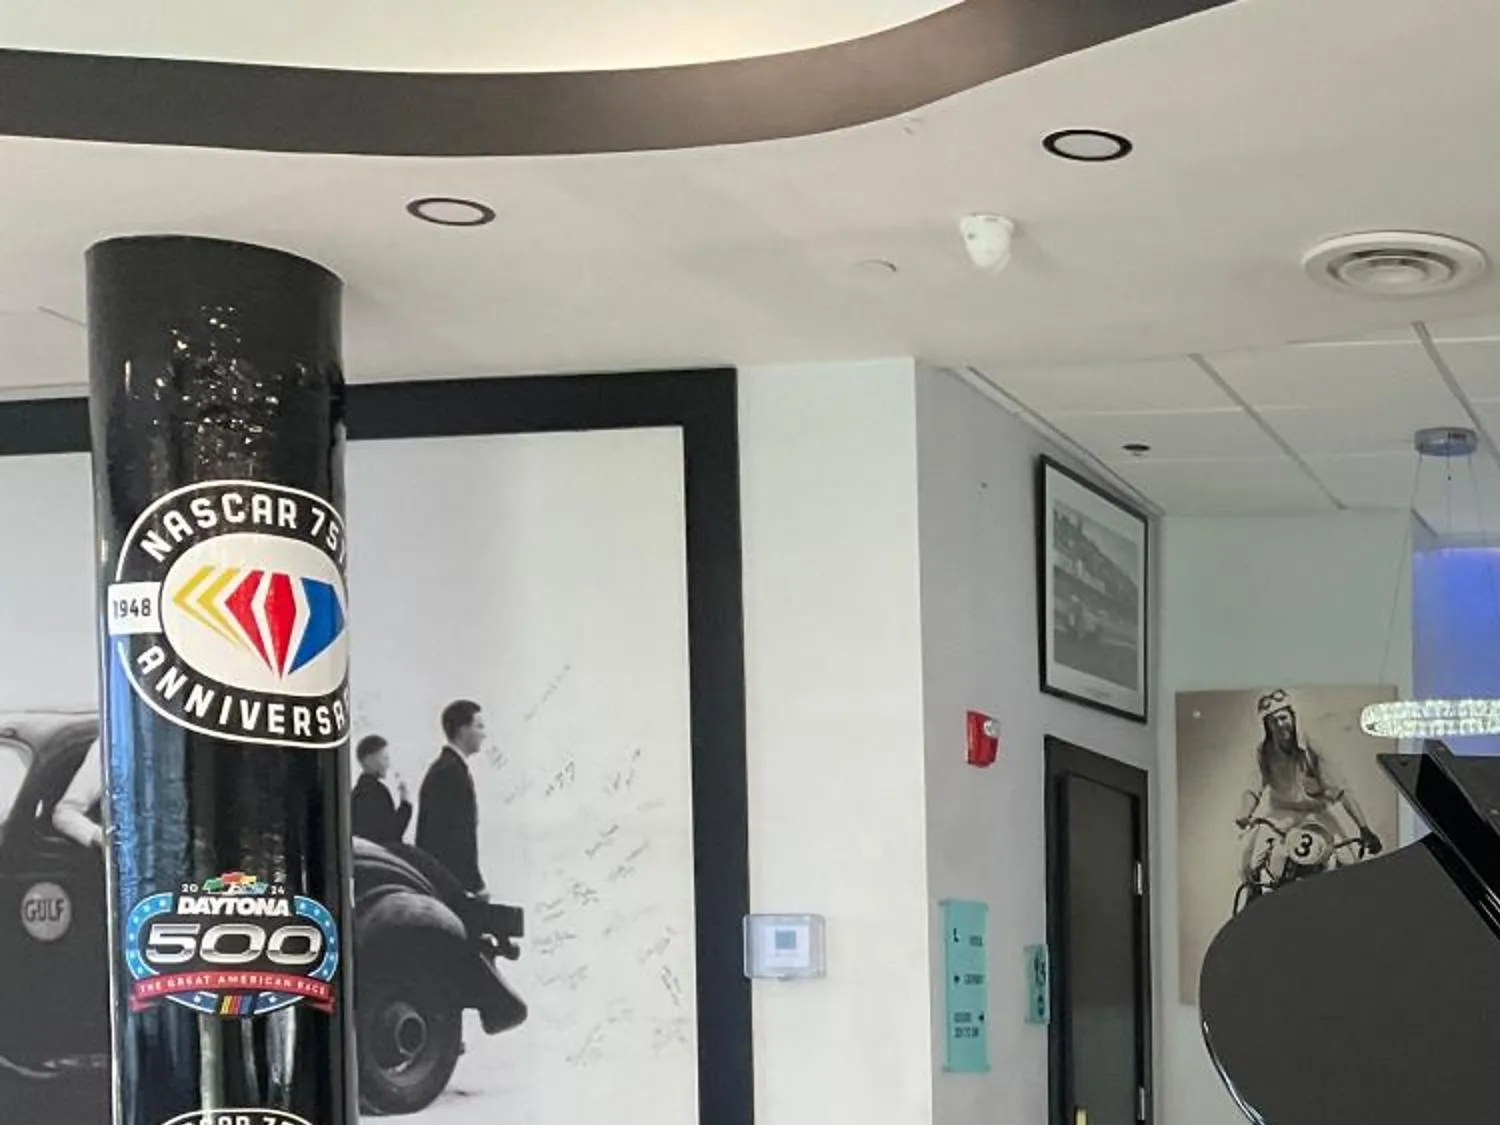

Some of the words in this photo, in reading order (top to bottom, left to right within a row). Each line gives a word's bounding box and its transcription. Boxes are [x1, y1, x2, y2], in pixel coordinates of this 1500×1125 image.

[139, 492, 297, 564] NASCAR
[309, 507, 347, 565] 75
[112, 597, 152, 621] 1948
[136, 645, 348, 737] ANNIVERSA
[1294, 833, 1314, 857] 3
[177, 895, 290, 917] DAYTONA
[146, 923, 323, 965] 500
